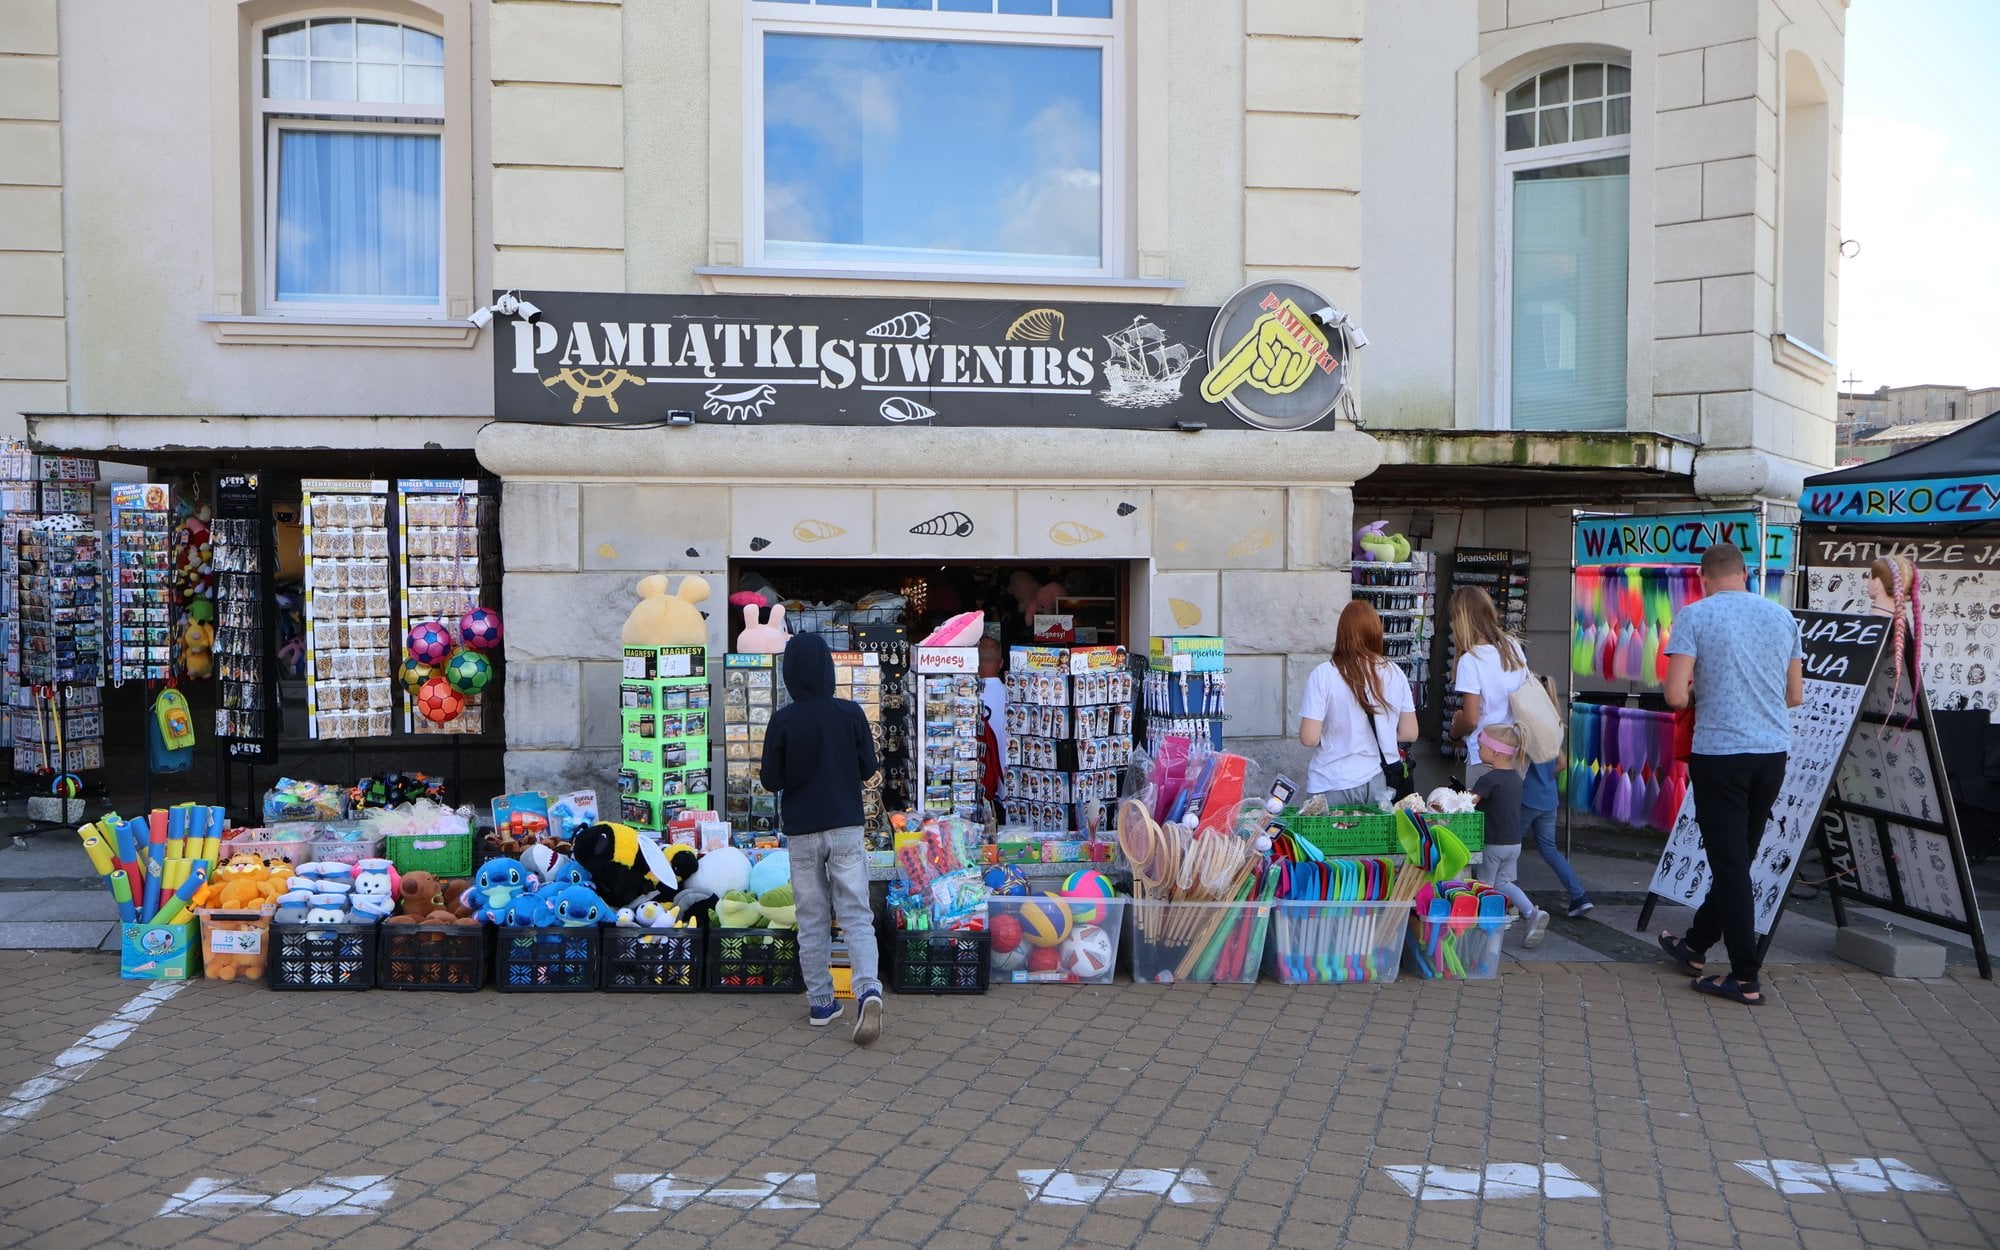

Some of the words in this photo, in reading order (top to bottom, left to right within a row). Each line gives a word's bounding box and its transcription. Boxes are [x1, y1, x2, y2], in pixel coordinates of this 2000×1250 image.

[511, 320, 819, 377] PAMIĄTKI
[820, 338, 1094, 389] SUWENIRS
[344, 481, 371, 489] SZCZĘŚCI
[435, 481, 463, 489] SZCZĘŚCI
[1811, 483, 2000, 516] WARKOCZY
[1583, 521, 1753, 557] WARKOCZYKI
[1457, 552, 1508, 562] Bransoletki
[1819, 541, 1964, 563] TATUAŻE
[1794, 618, 1883, 644] UAŻE
[625, 649, 655, 657] MAGNESY
[920, 654, 964, 668] Magnesy
[237, 742, 261, 753] PETS
